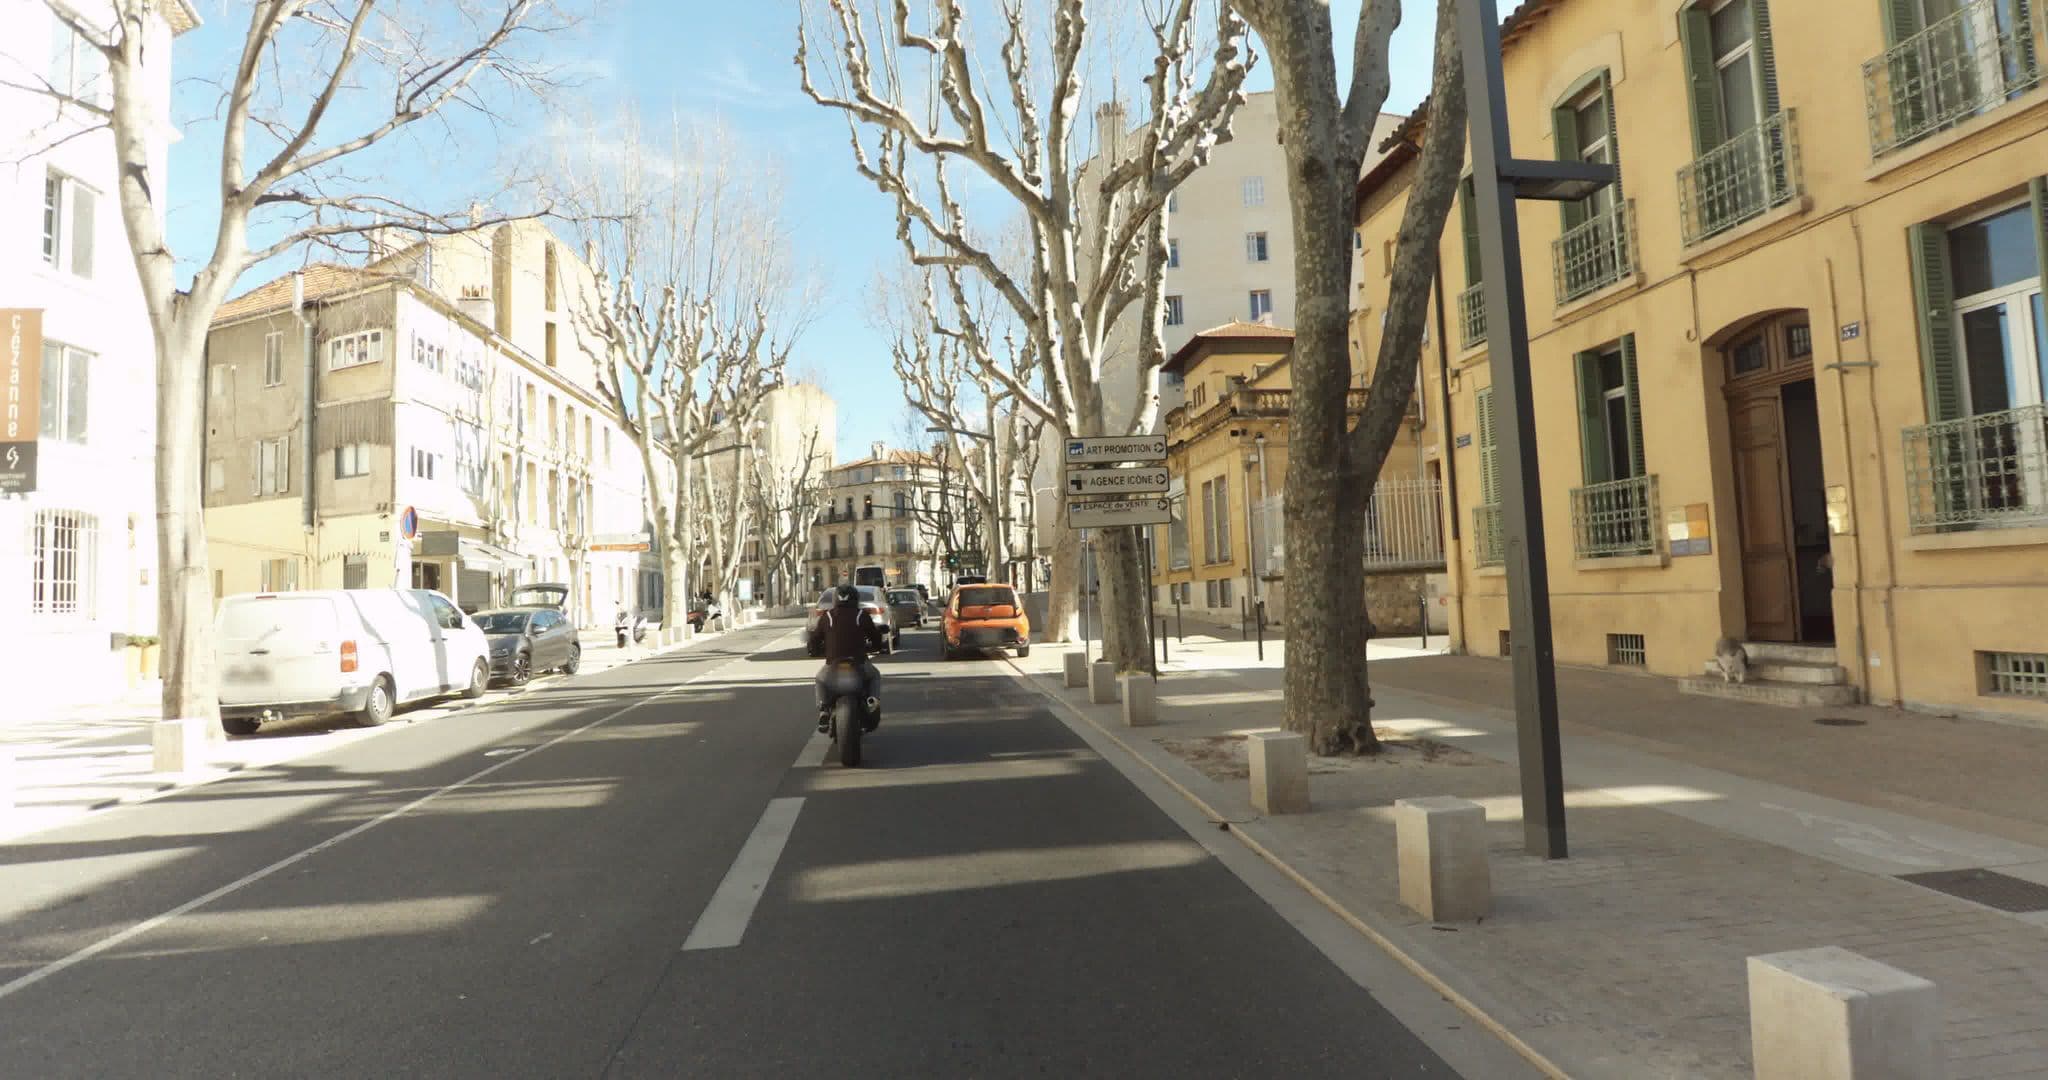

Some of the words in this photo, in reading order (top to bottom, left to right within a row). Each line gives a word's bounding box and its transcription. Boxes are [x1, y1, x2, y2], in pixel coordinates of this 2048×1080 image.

[1086, 447, 1102, 455] ART
[1104, 444, 1151, 454] PROMOTION
[1090, 476, 1125, 486] AGENCE
